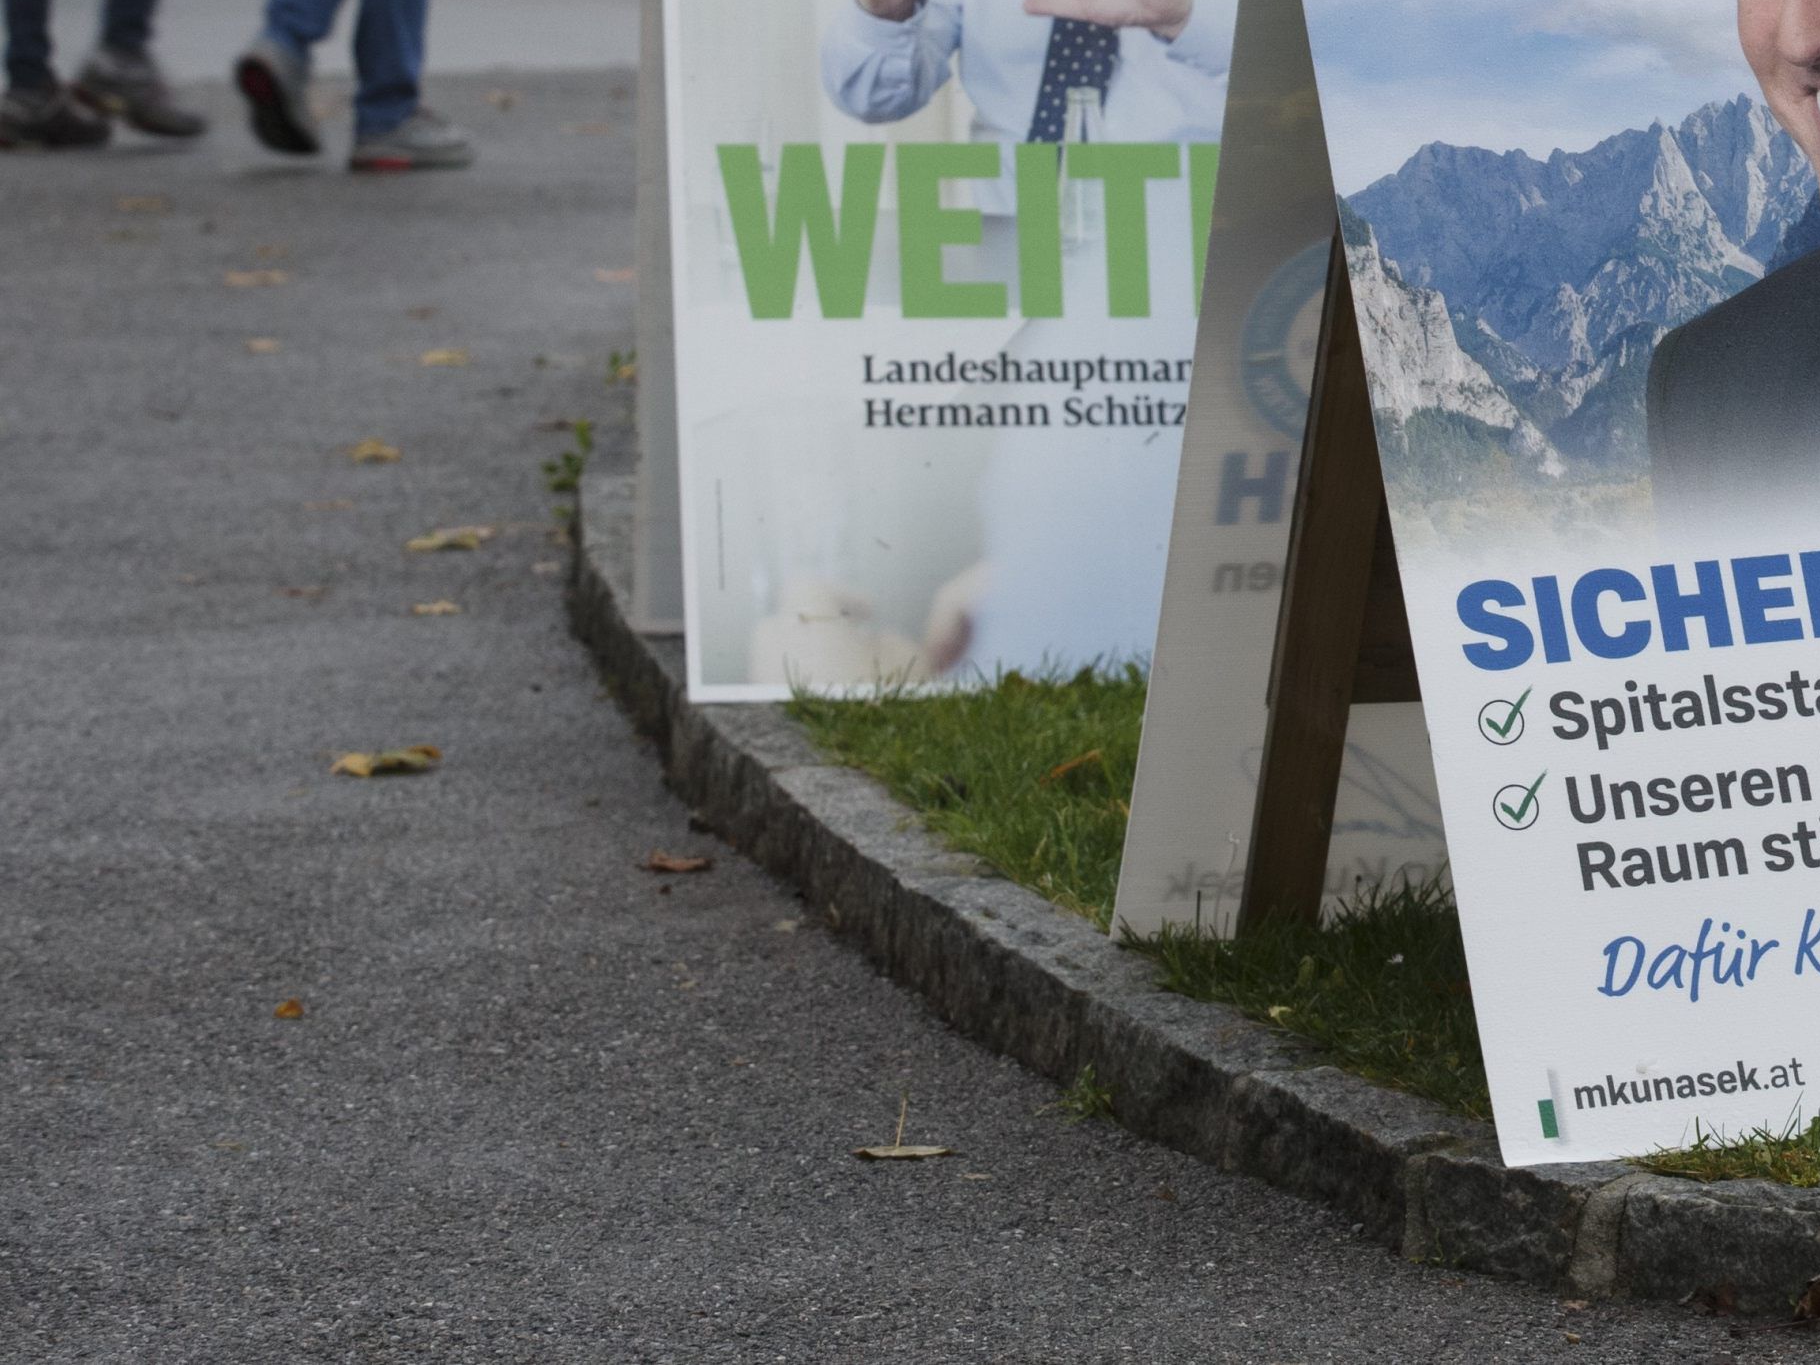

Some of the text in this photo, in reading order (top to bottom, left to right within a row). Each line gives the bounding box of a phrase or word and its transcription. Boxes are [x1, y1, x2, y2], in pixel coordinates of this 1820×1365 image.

[716, 142, 1222, 320] WEIT
[864, 396, 1187, 427] Hermann Schütz
[1566, 755, 1814, 826] Unseren
[1577, 835, 1748, 893] Raum
[1597, 917, 1780, 1003] Dafür
[1573, 1057, 1806, 1110] mkunasek.at
